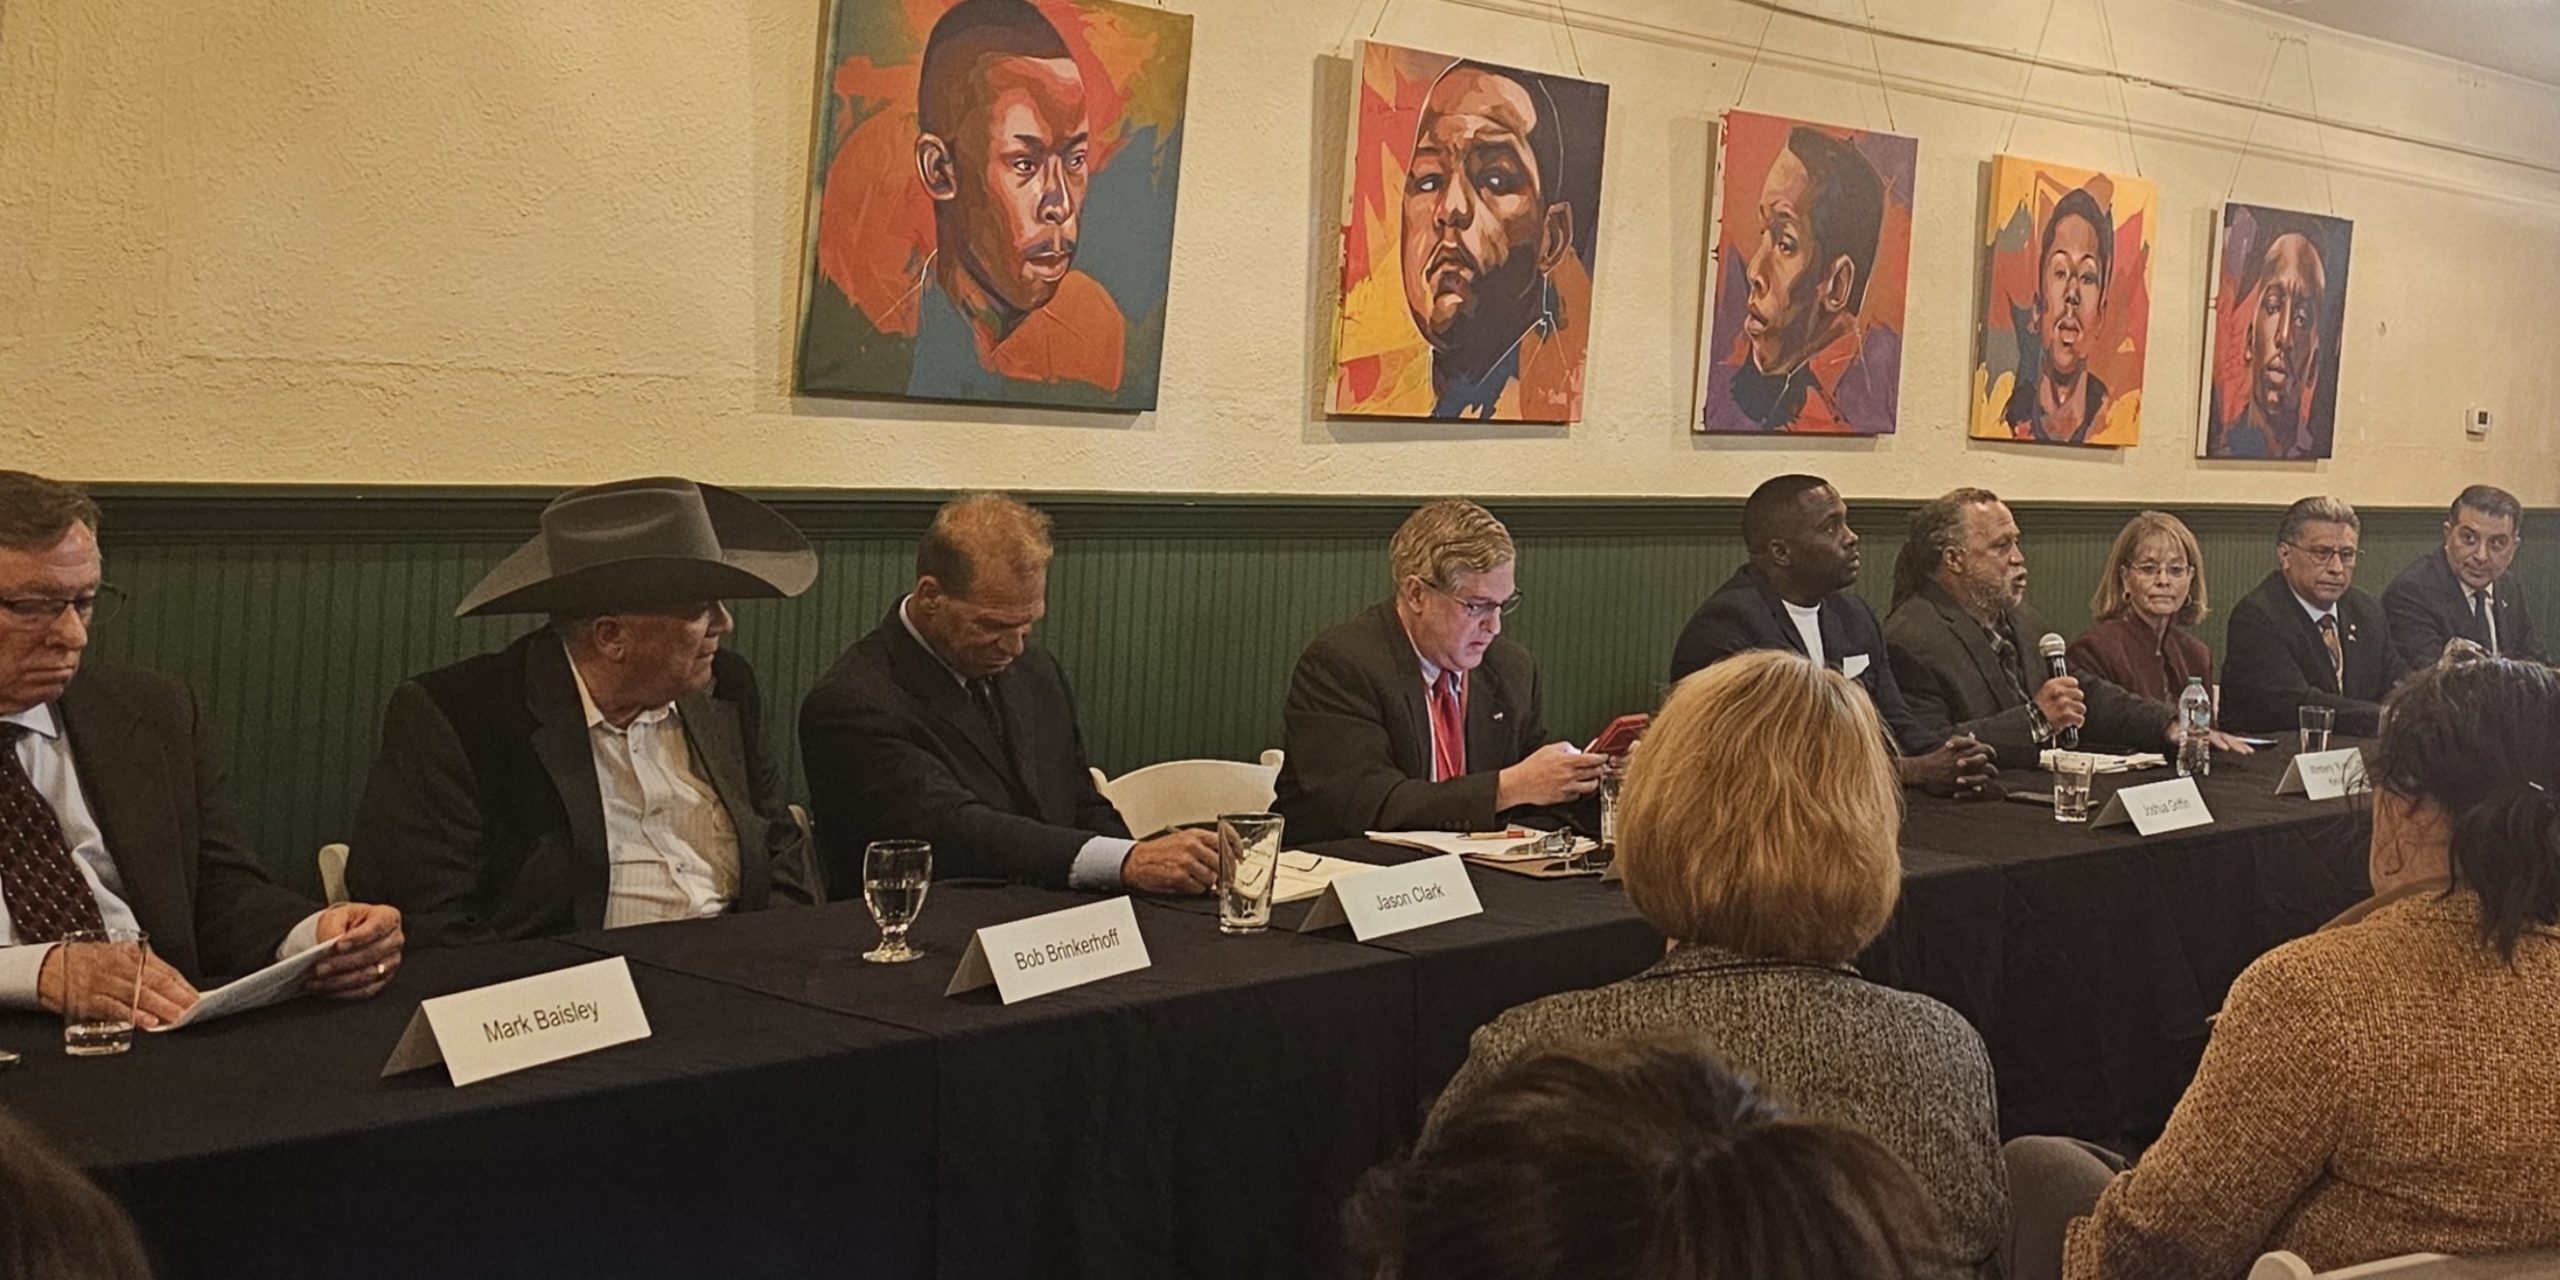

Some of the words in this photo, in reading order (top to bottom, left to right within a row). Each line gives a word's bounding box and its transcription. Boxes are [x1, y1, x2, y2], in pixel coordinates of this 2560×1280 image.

[2143, 803, 2169, 816] Joshua
[1376, 893, 1412, 911] Jason
[1412, 883, 1446, 903] Clark
[1014, 949, 1045, 970] Bob
[1046, 928, 1120, 963] Brinkerhoff
[483, 1015, 533, 1043] Mark
[533, 1001, 599, 1031] Baisley
